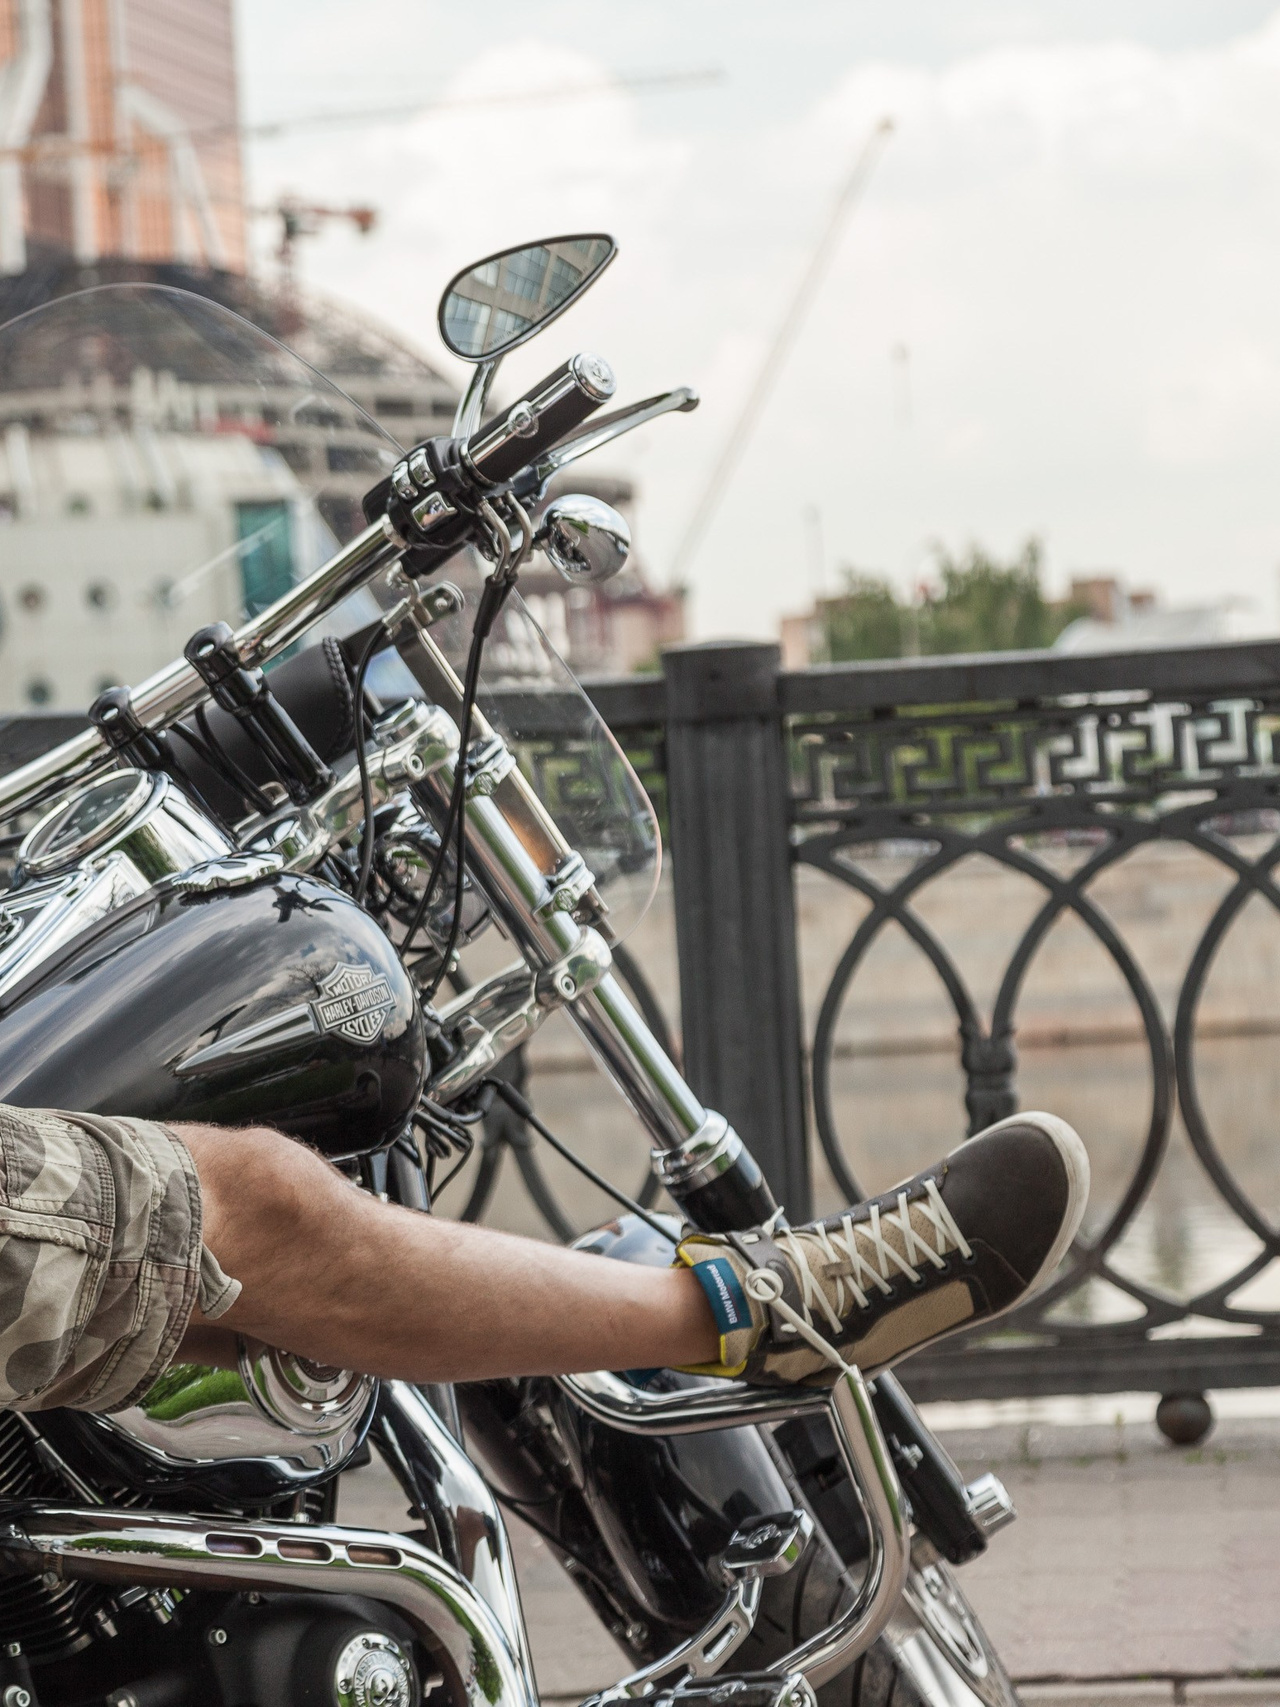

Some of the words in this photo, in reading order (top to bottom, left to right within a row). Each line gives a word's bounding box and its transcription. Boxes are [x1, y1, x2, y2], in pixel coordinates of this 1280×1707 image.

[331, 972, 370, 997] MOTOR
[323, 984, 391, 1022] HARLEY-DAVIDSON
[345, 1010, 382, 1037] CYCLES
[706, 1264, 730, 1301] Motorrad
[723, 1299, 738, 1325] BMW
